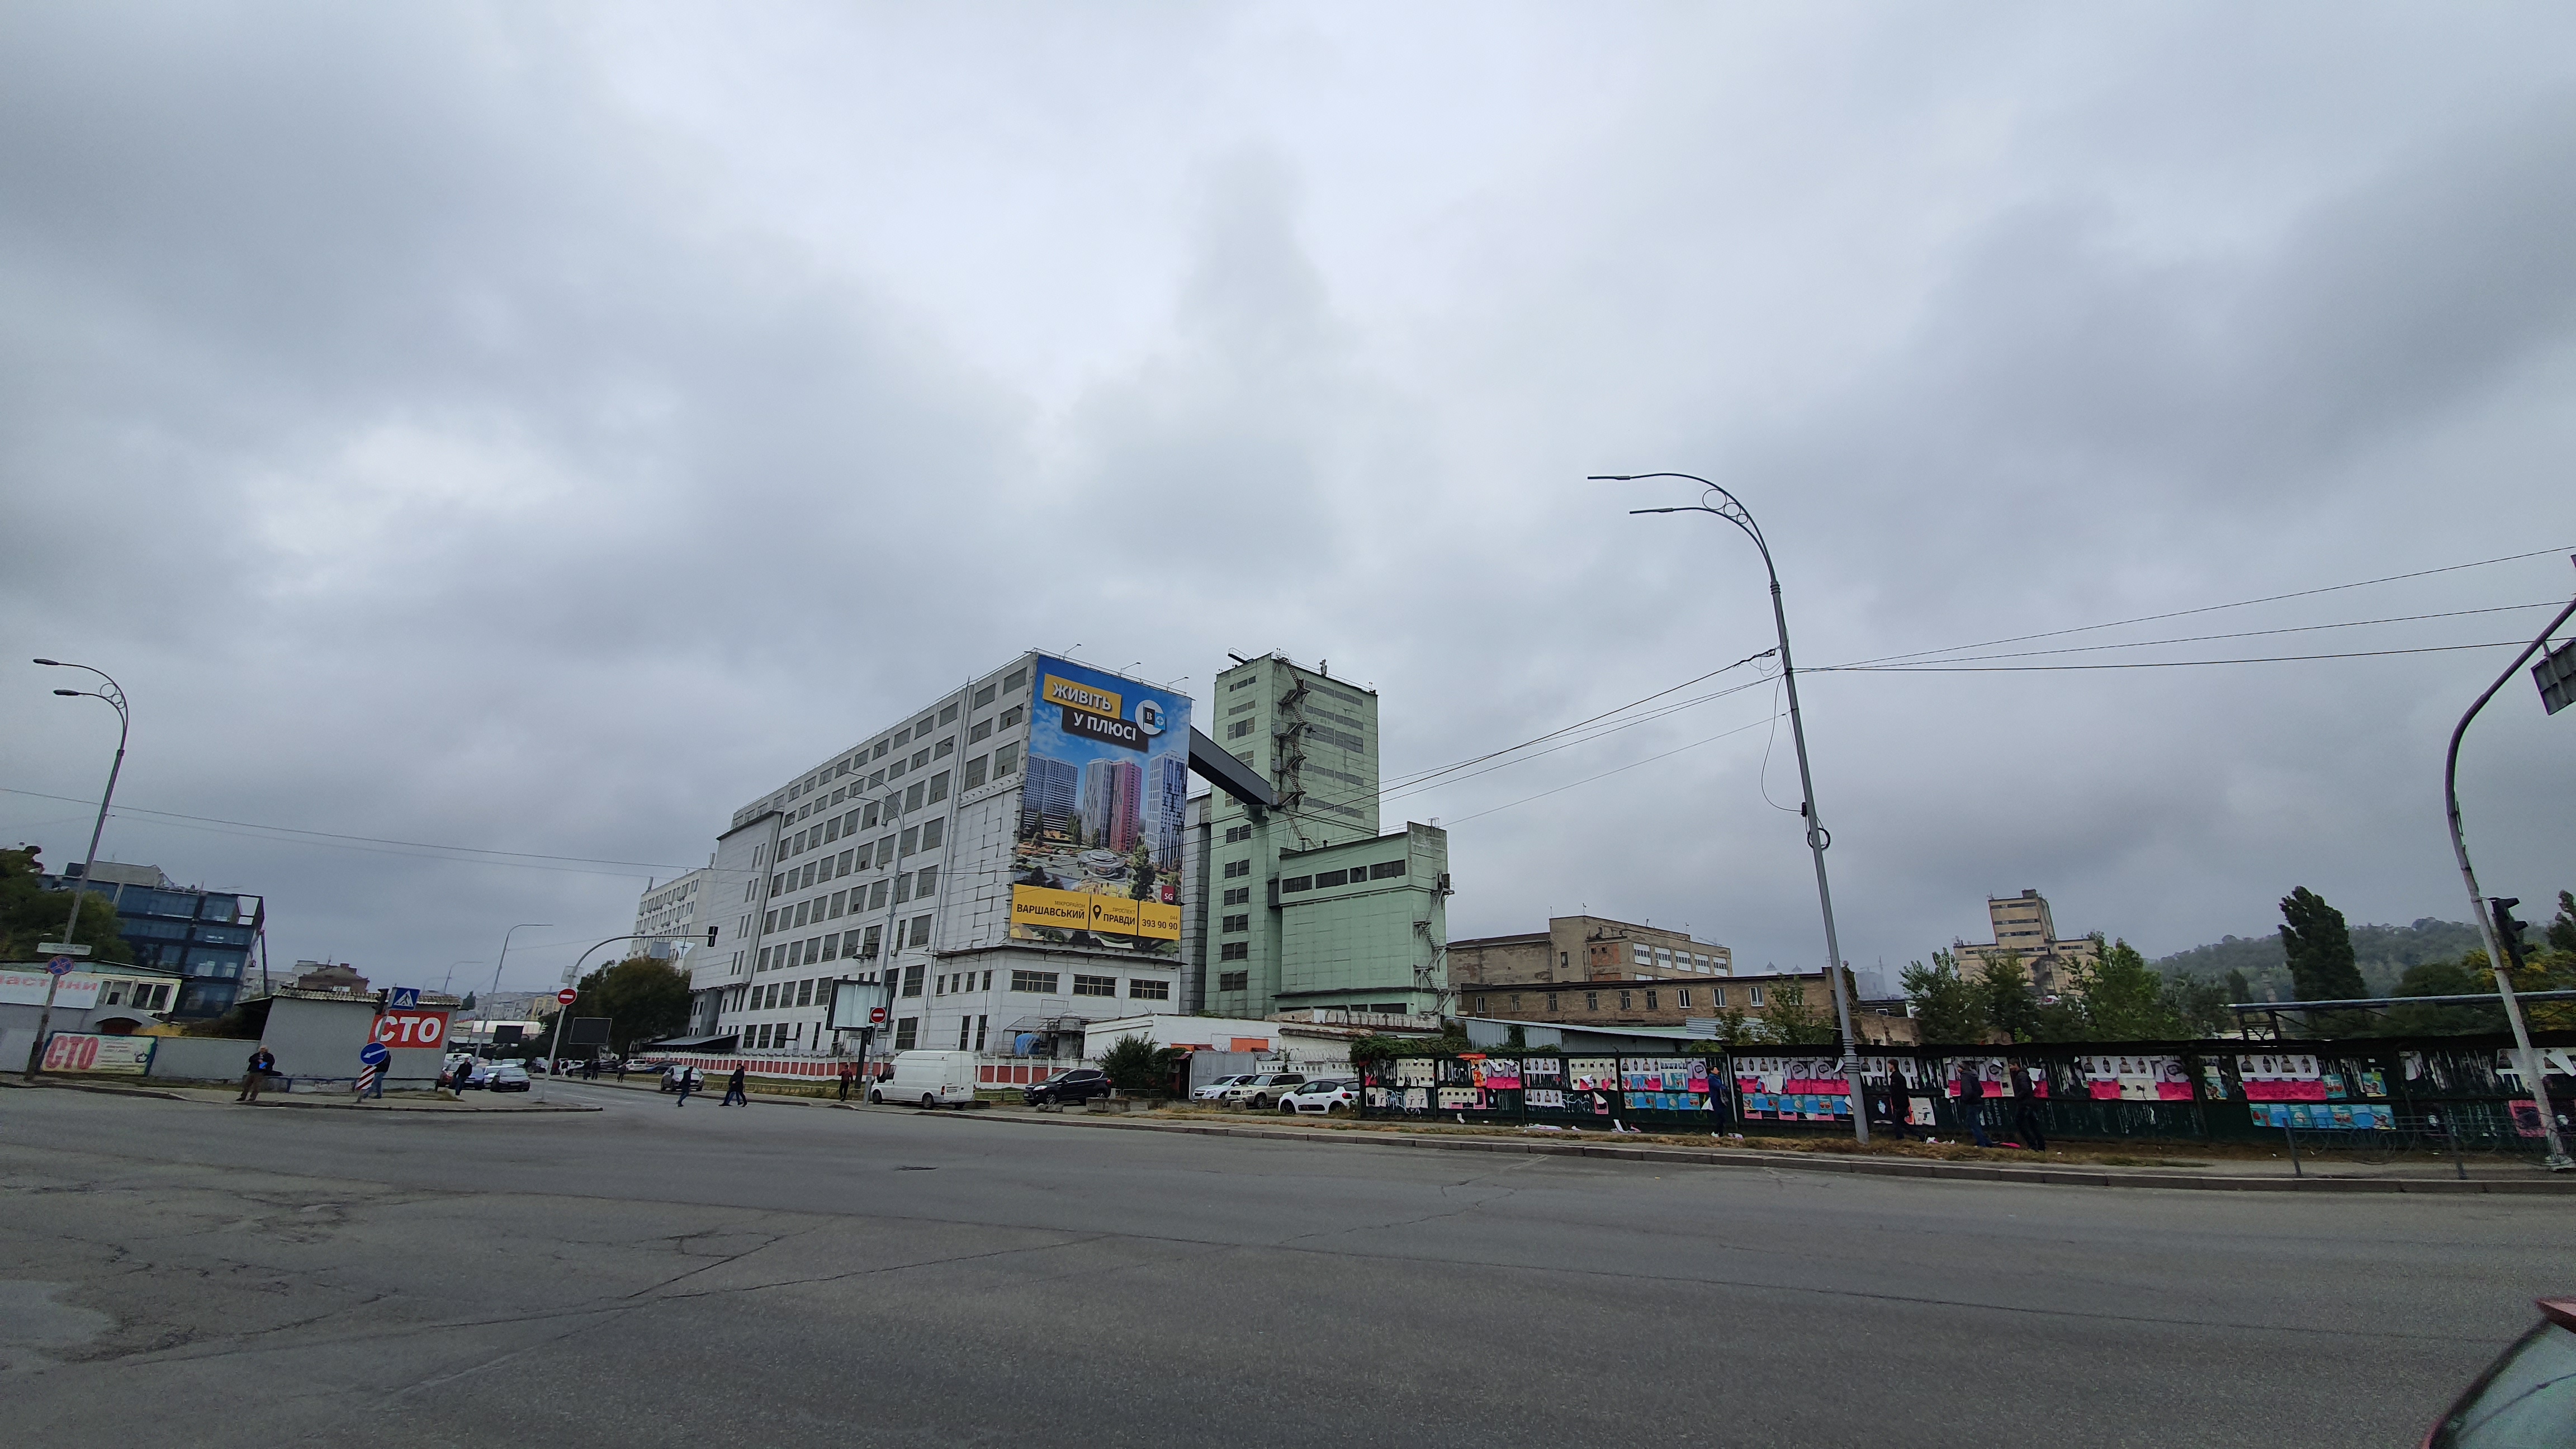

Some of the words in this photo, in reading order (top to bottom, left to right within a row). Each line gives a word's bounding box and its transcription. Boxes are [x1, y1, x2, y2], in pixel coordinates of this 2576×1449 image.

[1052, 682, 1111, 711] ЖИВІТЬ
[1073, 712, 1083, 727] У
[1087, 716, 1136, 741] ПЛЮСІ
[1016, 904, 1085, 919] ВАРШАВСЬКИЙ
[1104, 913, 1135, 926] ПРАВДИ
[1142, 919, 1156, 927] 393
[375, 1016, 441, 1043] СТО
[46, 1035, 99, 1070] СТО
